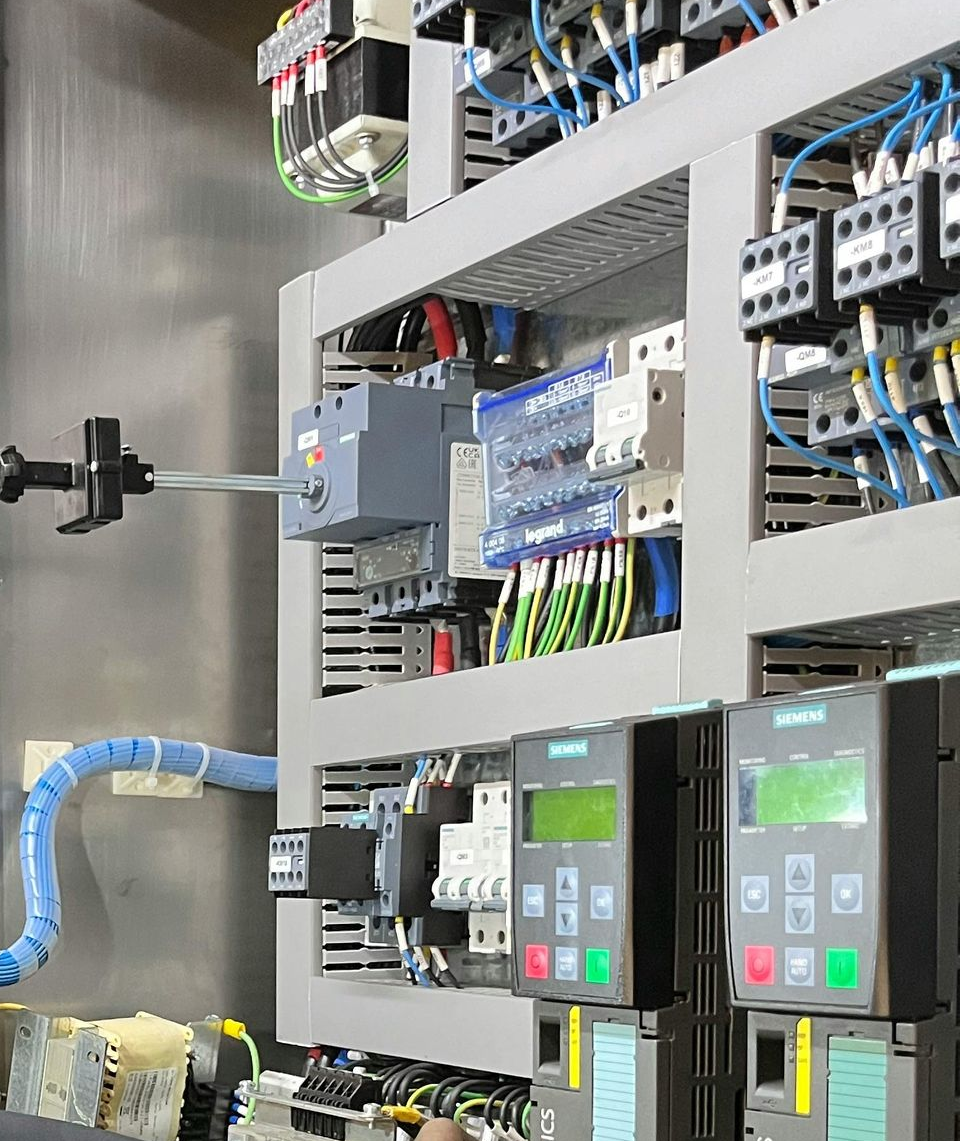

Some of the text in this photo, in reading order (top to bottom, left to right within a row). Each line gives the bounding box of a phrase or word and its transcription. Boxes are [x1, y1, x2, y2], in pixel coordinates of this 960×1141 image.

[525, 518, 565, 545] legrand
[775, 709, 824, 726] SIEMENS
[550, 742, 588, 756] SIEMENS
